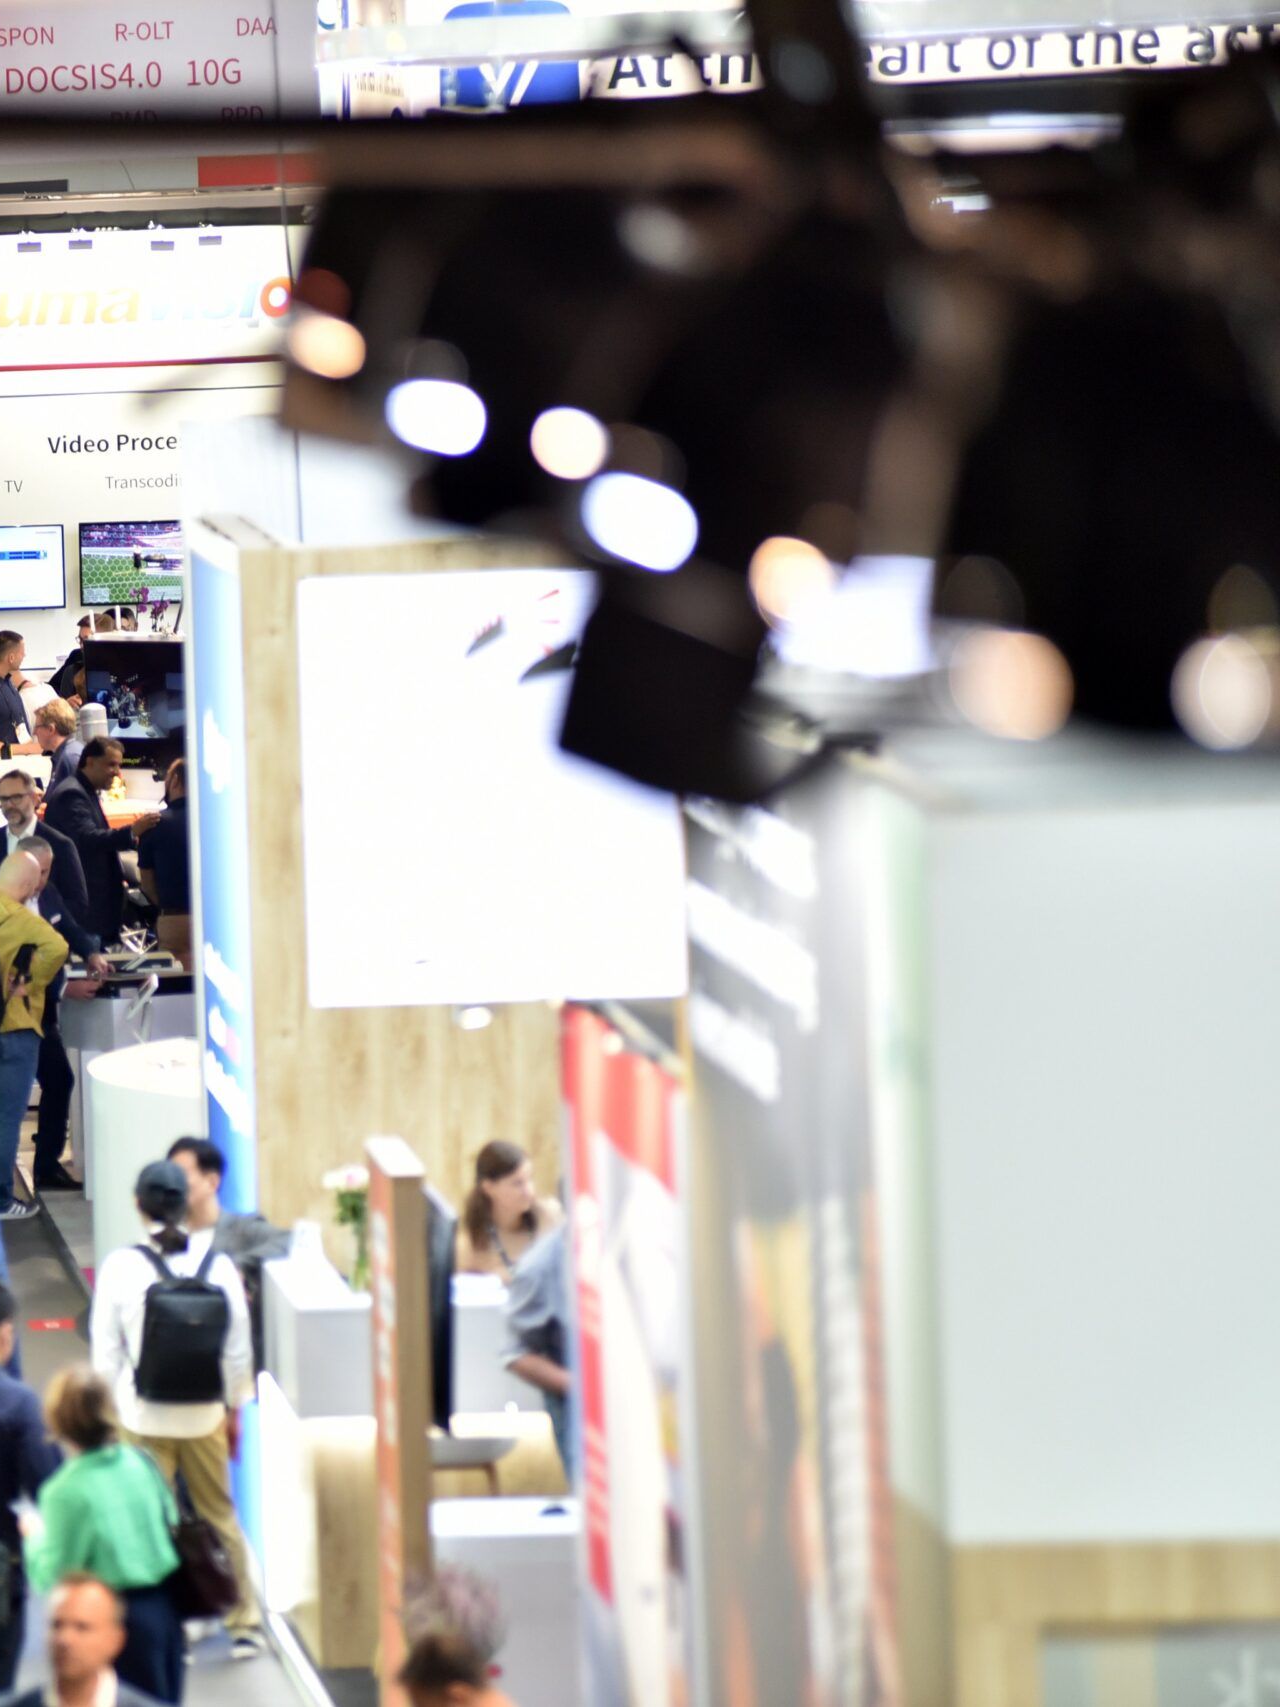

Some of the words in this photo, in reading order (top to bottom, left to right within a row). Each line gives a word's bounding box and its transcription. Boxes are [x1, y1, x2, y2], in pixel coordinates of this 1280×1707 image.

[115, 21, 174, 41] R-OLT
[236, 16, 278, 37] DAA
[5, 61, 162, 94] DOCSIS4.0
[187, 58, 242, 86] 10G
[48, 434, 109, 454] Video
[117, 434, 180, 451] Proce
[4, 480, 23, 493] TV
